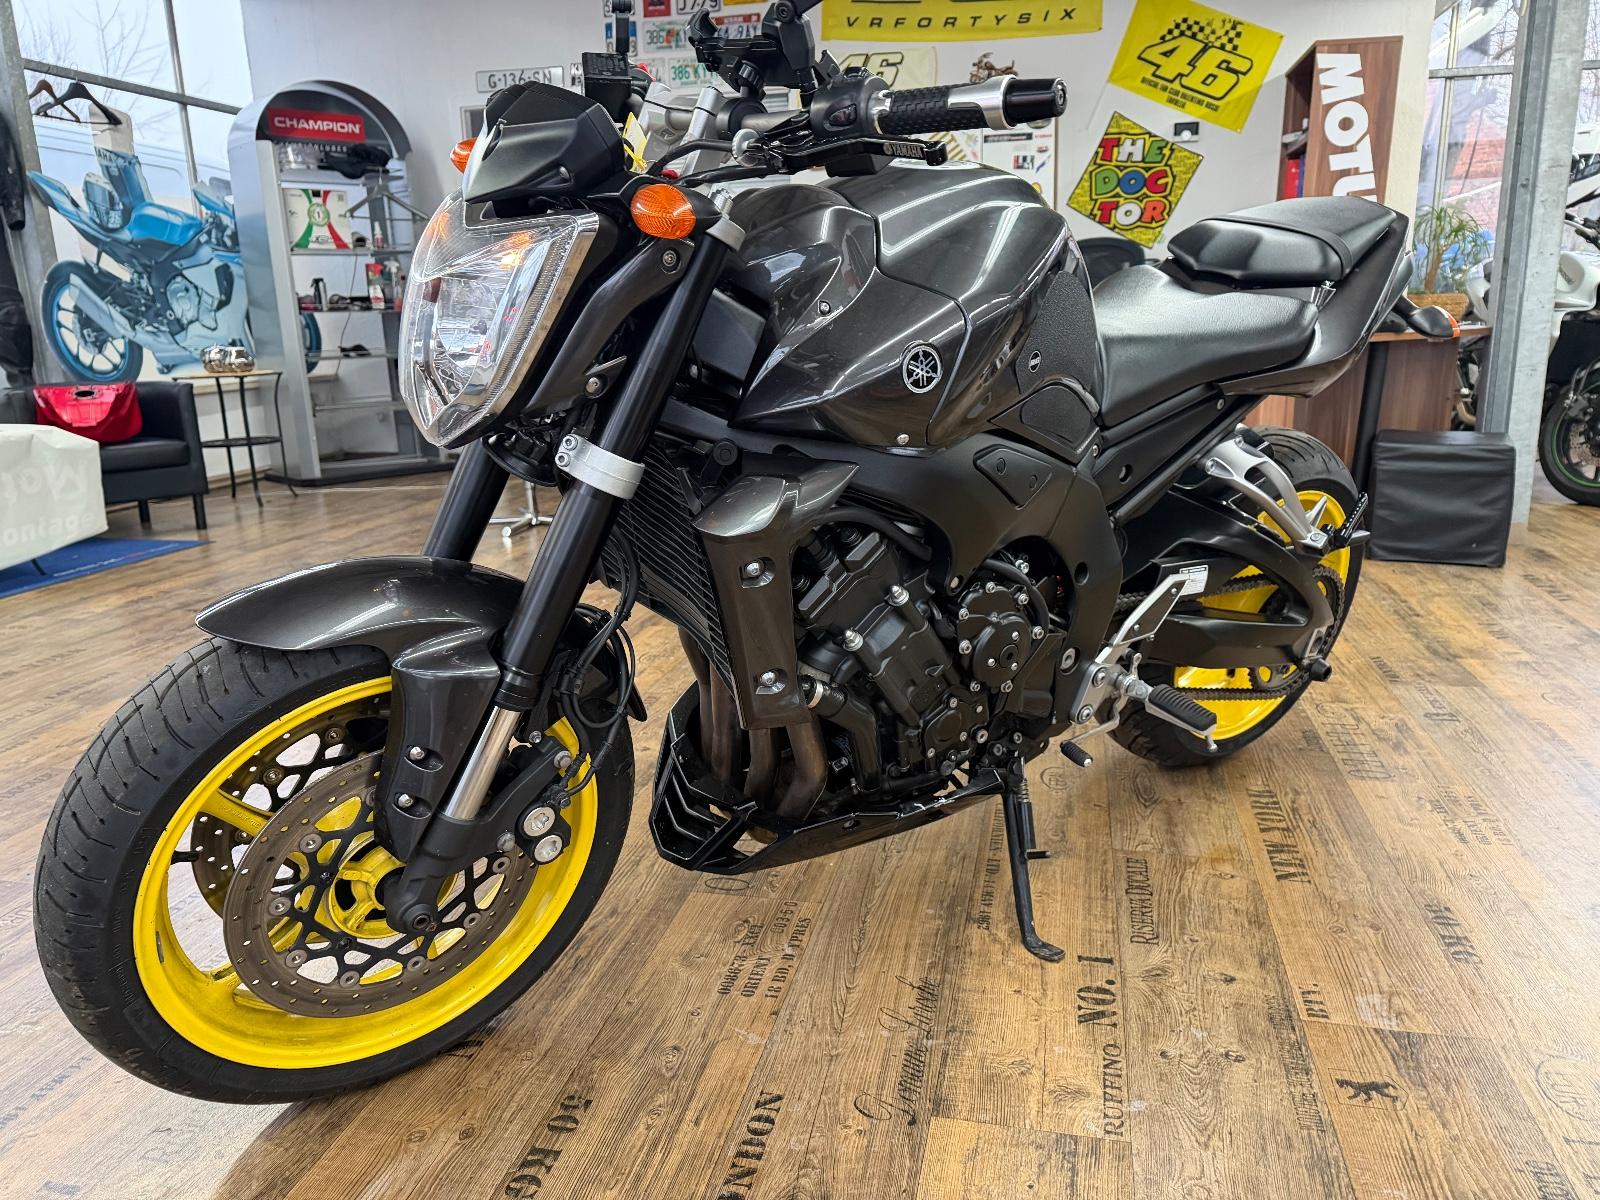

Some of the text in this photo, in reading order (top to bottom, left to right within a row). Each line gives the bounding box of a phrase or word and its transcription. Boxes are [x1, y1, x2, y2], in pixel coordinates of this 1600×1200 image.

[846, 8, 1076, 28] VRFORTYSIX
[1137, 32, 1254, 102] 46
[274, 116, 361, 134] CHAMPION
[892, 143, 924, 159] YAMAHA
[1099, 136, 1167, 164] THE
[1094, 167, 1171, 196] DOC
[1097, 200, 1166, 226] TOR
[1262, 839, 1312, 884] NEW
[1125, 857, 1160, 947] RISERVA DUCALE
[741, 955, 771, 998] ORIENT
[1076, 954, 1118, 1029] NO. 1
[1103, 1042, 1125, 1138] RUFFINO
[546, 1094, 594, 1135] 50
